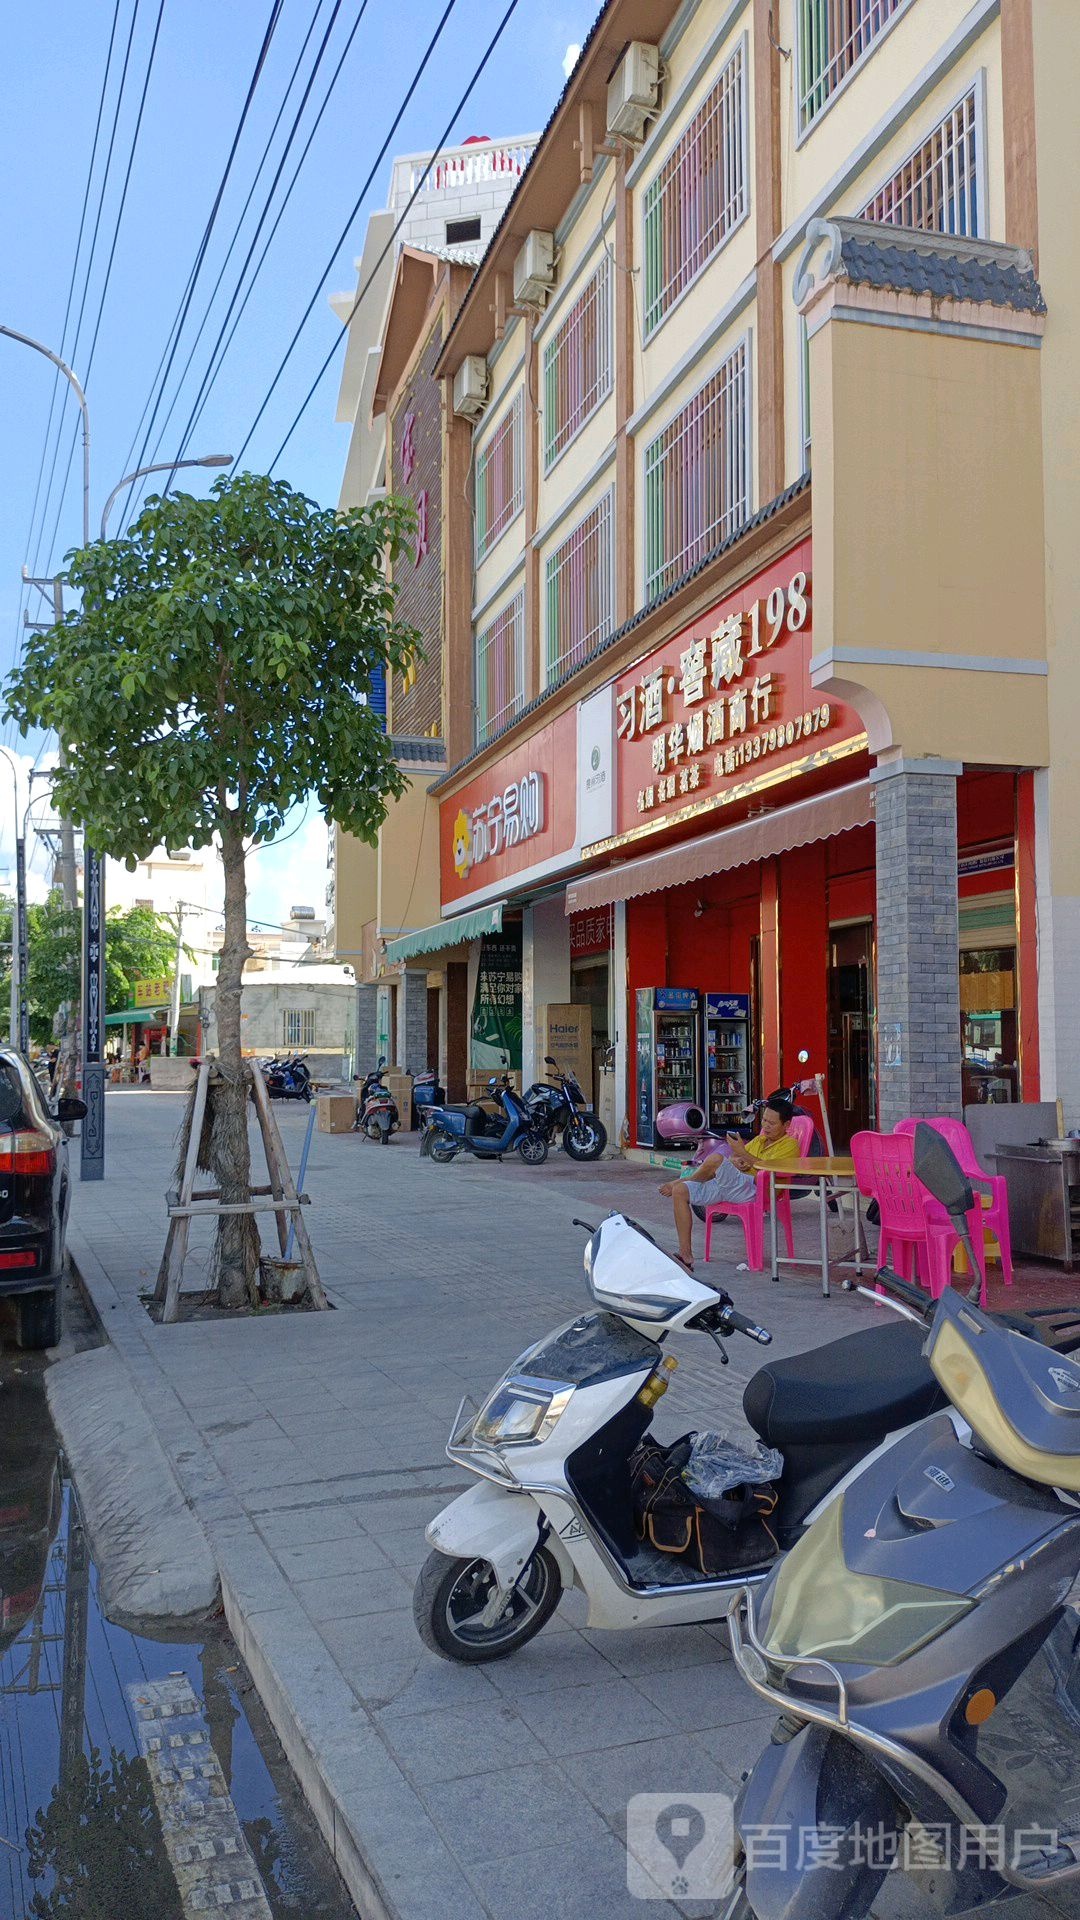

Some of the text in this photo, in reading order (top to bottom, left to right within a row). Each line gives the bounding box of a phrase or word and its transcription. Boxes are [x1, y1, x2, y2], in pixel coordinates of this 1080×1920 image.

[652, 673, 772, 774] 明华烟酒商行
[473, 771, 543, 864] 苏宁易购
[480, 971, 522, 983] 来苏宁易购
[550, 1024, 578, 1033] Haier
